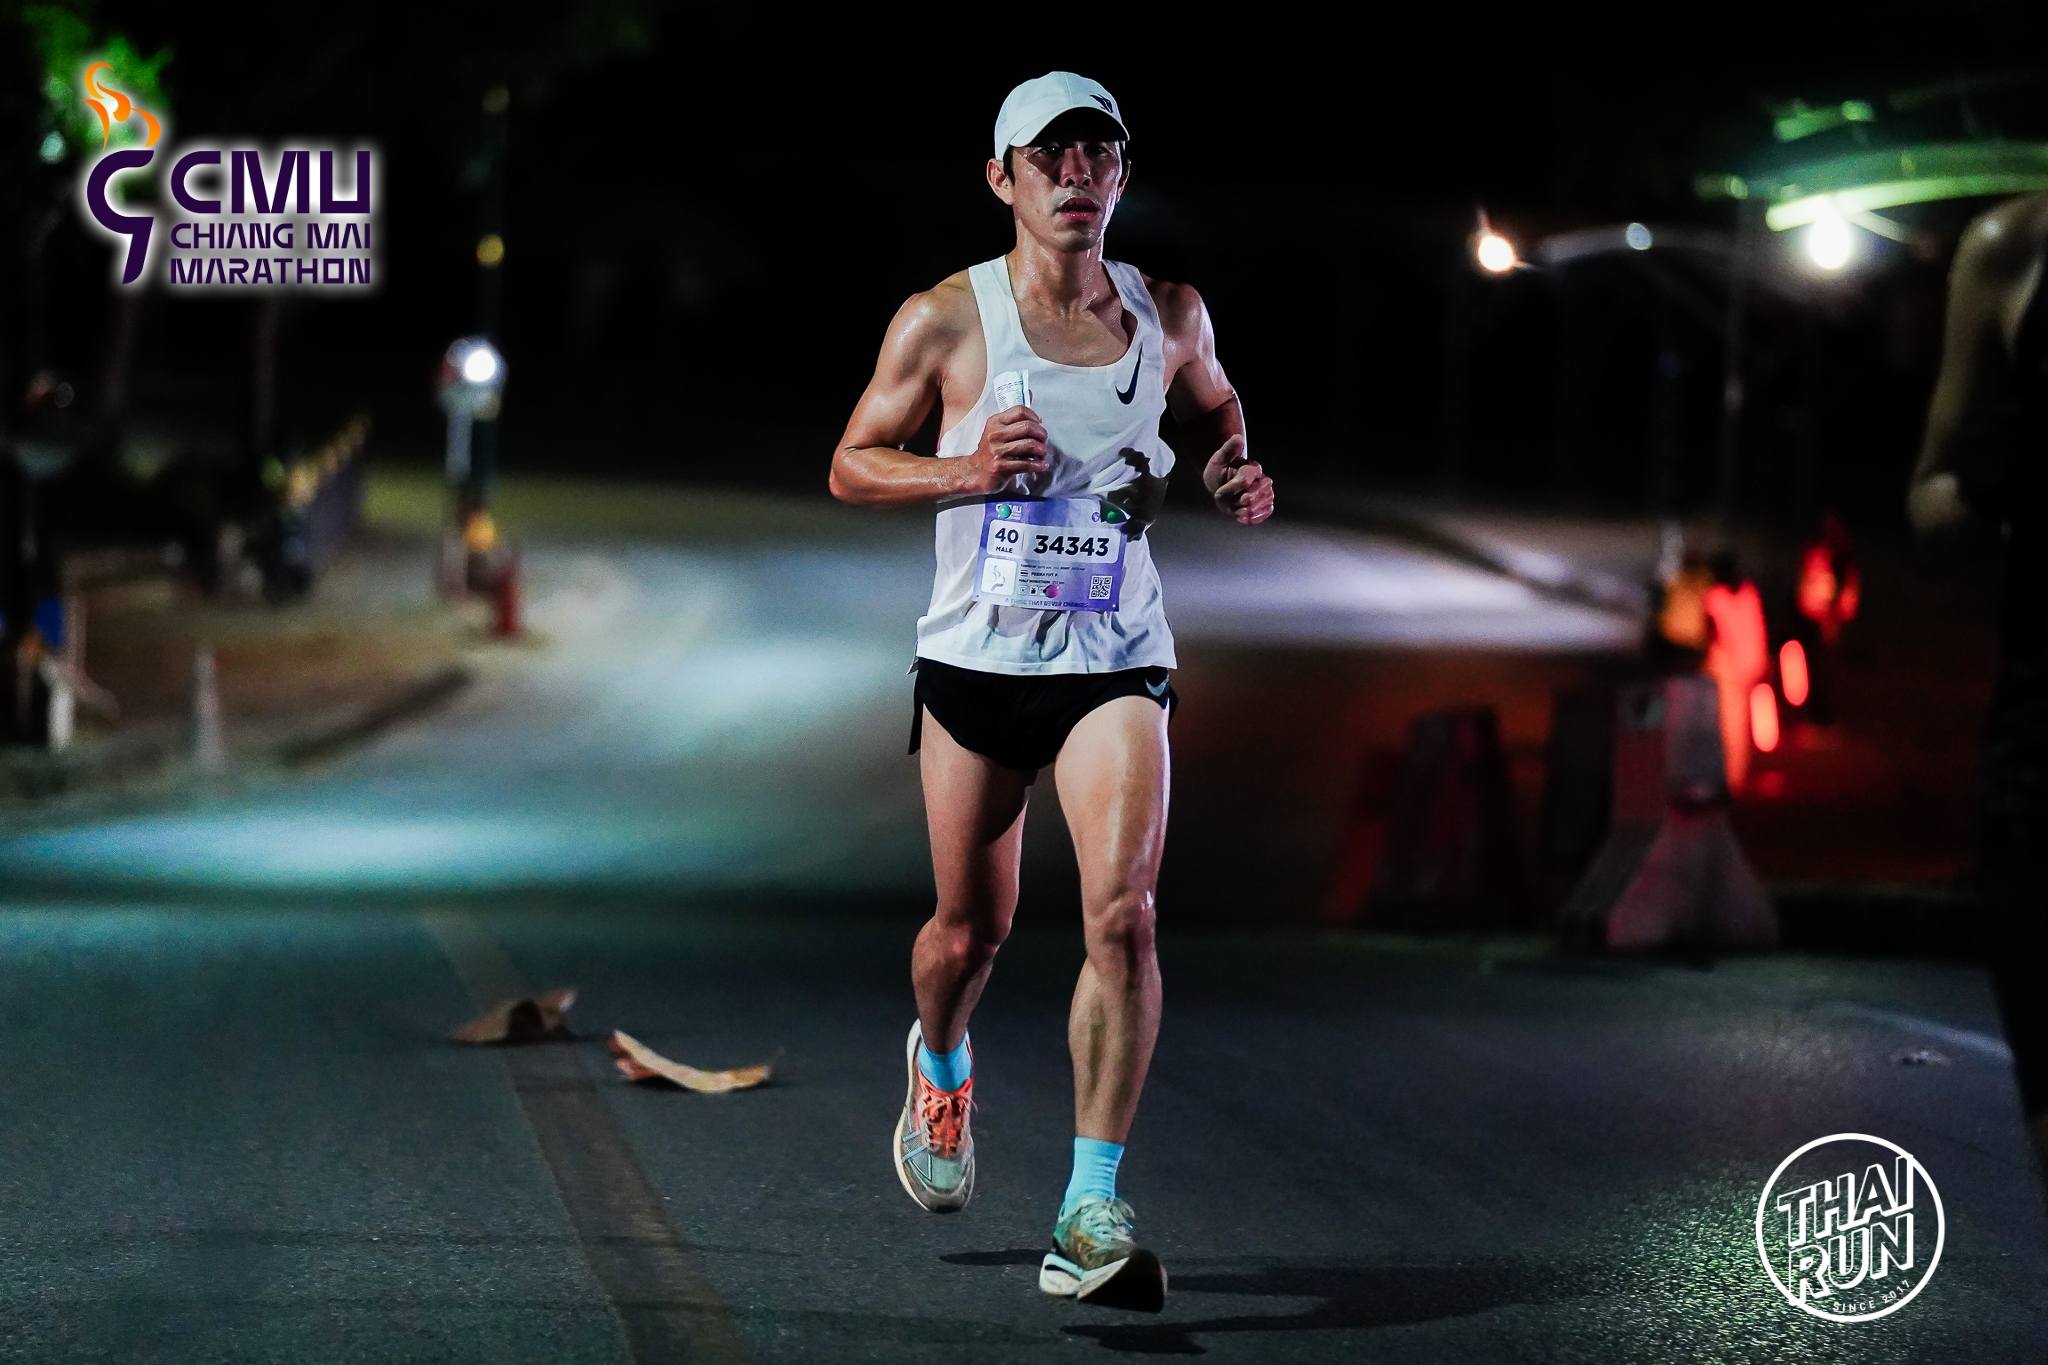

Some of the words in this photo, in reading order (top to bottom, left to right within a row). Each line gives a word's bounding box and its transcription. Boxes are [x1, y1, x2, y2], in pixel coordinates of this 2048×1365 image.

[994, 527, 1019, 544] 40
[995, 546, 1013, 554] MALE
[1033, 534, 1109, 556] 34343
